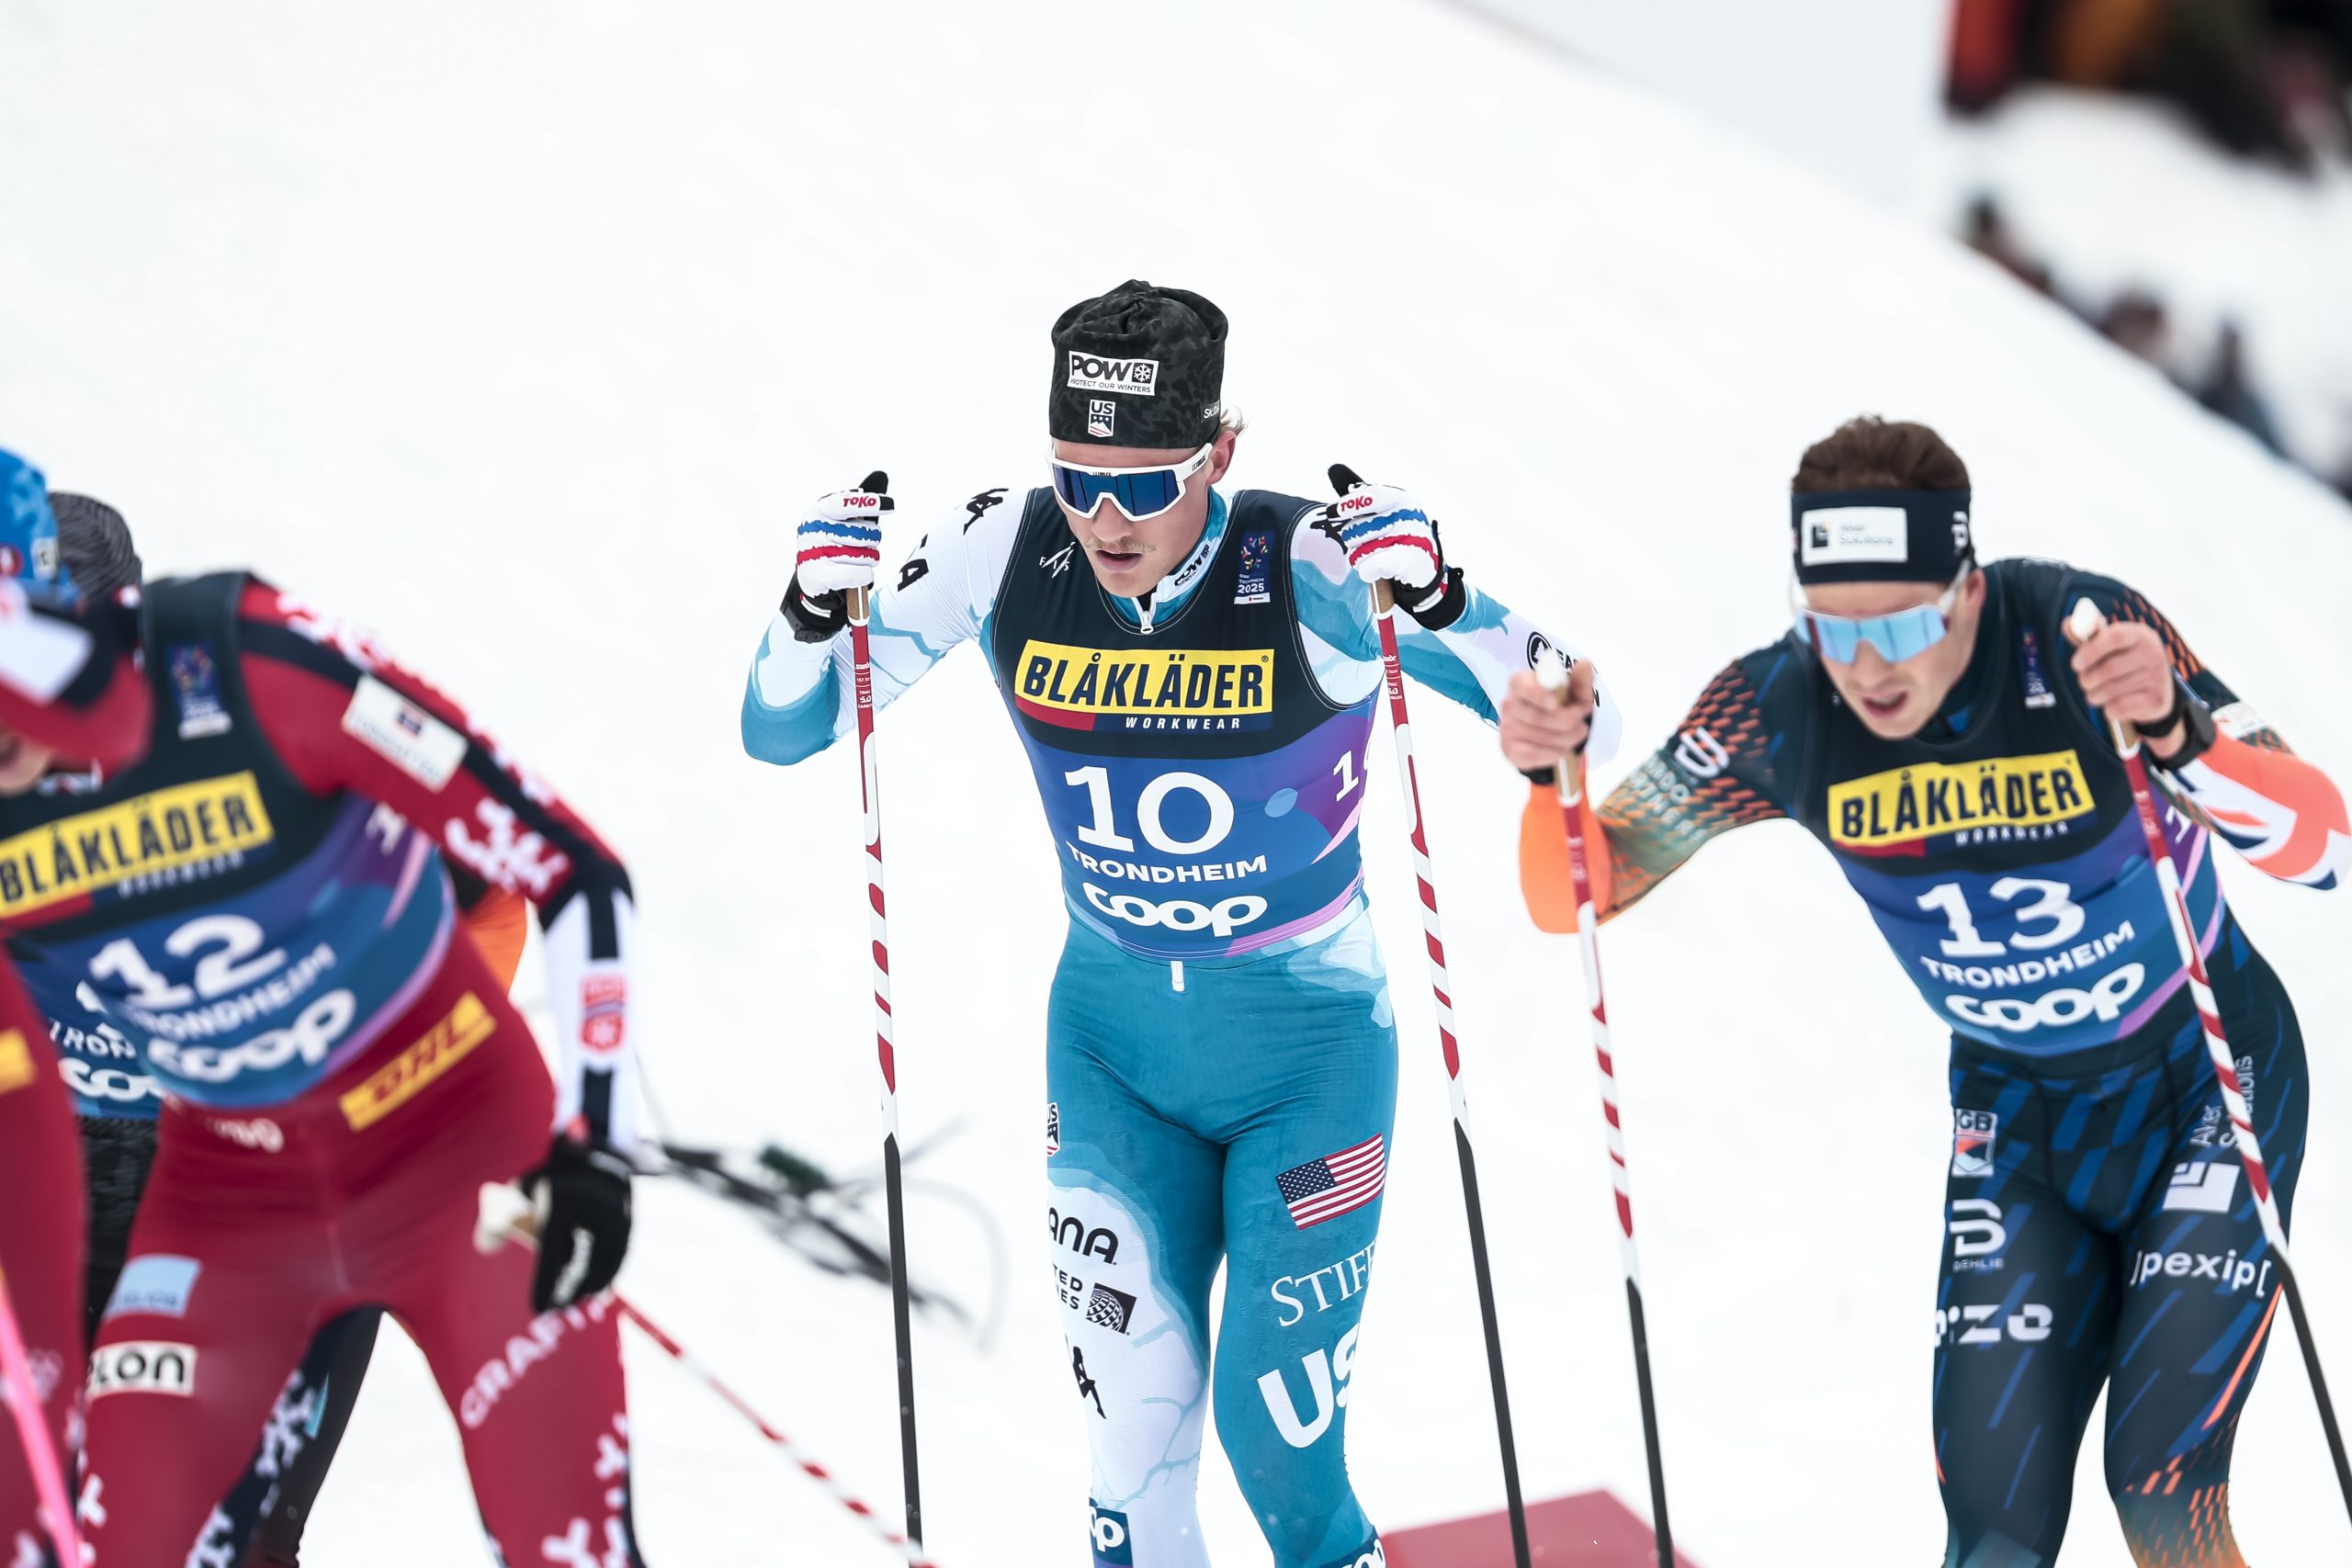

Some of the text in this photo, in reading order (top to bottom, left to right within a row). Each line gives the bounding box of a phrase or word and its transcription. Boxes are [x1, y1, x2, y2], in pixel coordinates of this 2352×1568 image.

[1071, 355, 1133, 381] POW
[1069, 378, 1151, 393] PROTECT OUR WINTERS
[1091, 400, 1114, 415] US
[842, 496, 877, 508] TOKO
[1340, 495, 1373, 512] TOKO
[1237, 582, 1265, 594] 2025
[1023, 651, 1264, 710] BLÅKLÄDER
[1125, 716, 1241, 730] WORKWEAR
[1063, 765, 1235, 855] 10
[1840, 762, 2083, 839] BLÅKLÄDER
[1954, 820, 2070, 847] WORKWEAR
[1065, 839, 1269, 884] TRONDHEIM
[1916, 876, 2086, 957] 13
[88, 913, 288, 1010] 12
[1919, 919, 2137, 989] TRONDHEIM
[1959, 1111, 1993, 1133] GB
